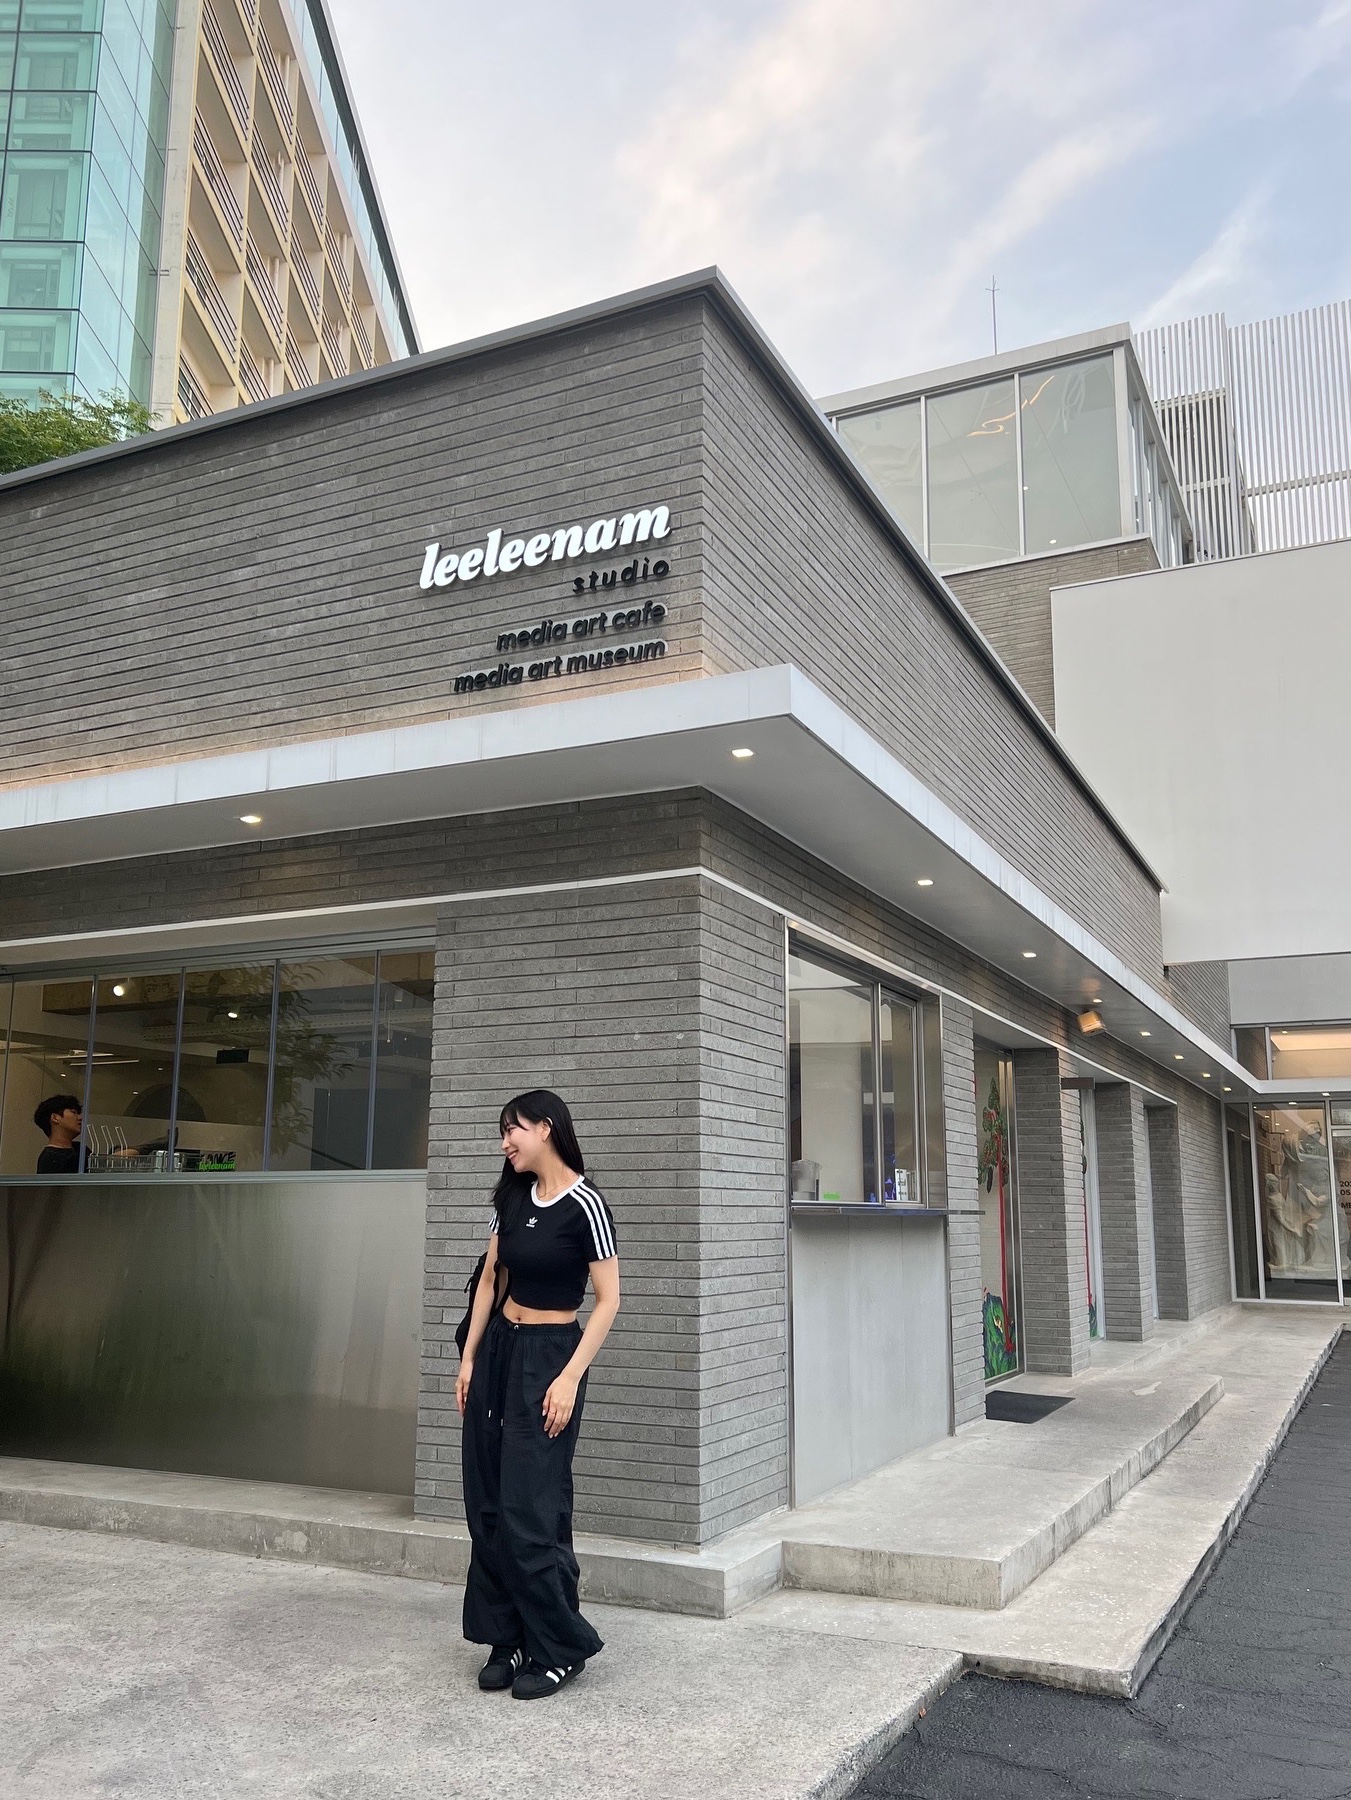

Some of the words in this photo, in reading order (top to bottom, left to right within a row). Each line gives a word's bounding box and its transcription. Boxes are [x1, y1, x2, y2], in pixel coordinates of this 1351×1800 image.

[419, 505, 671, 590] leeleenam
[573, 557, 670, 594] studio
[496, 620, 567, 651] media
[572, 611, 607, 637] art
[611, 600, 667, 630] cafe
[454, 663, 523, 692] media
[528, 655, 562, 679] art
[566, 639, 667, 673] museum
